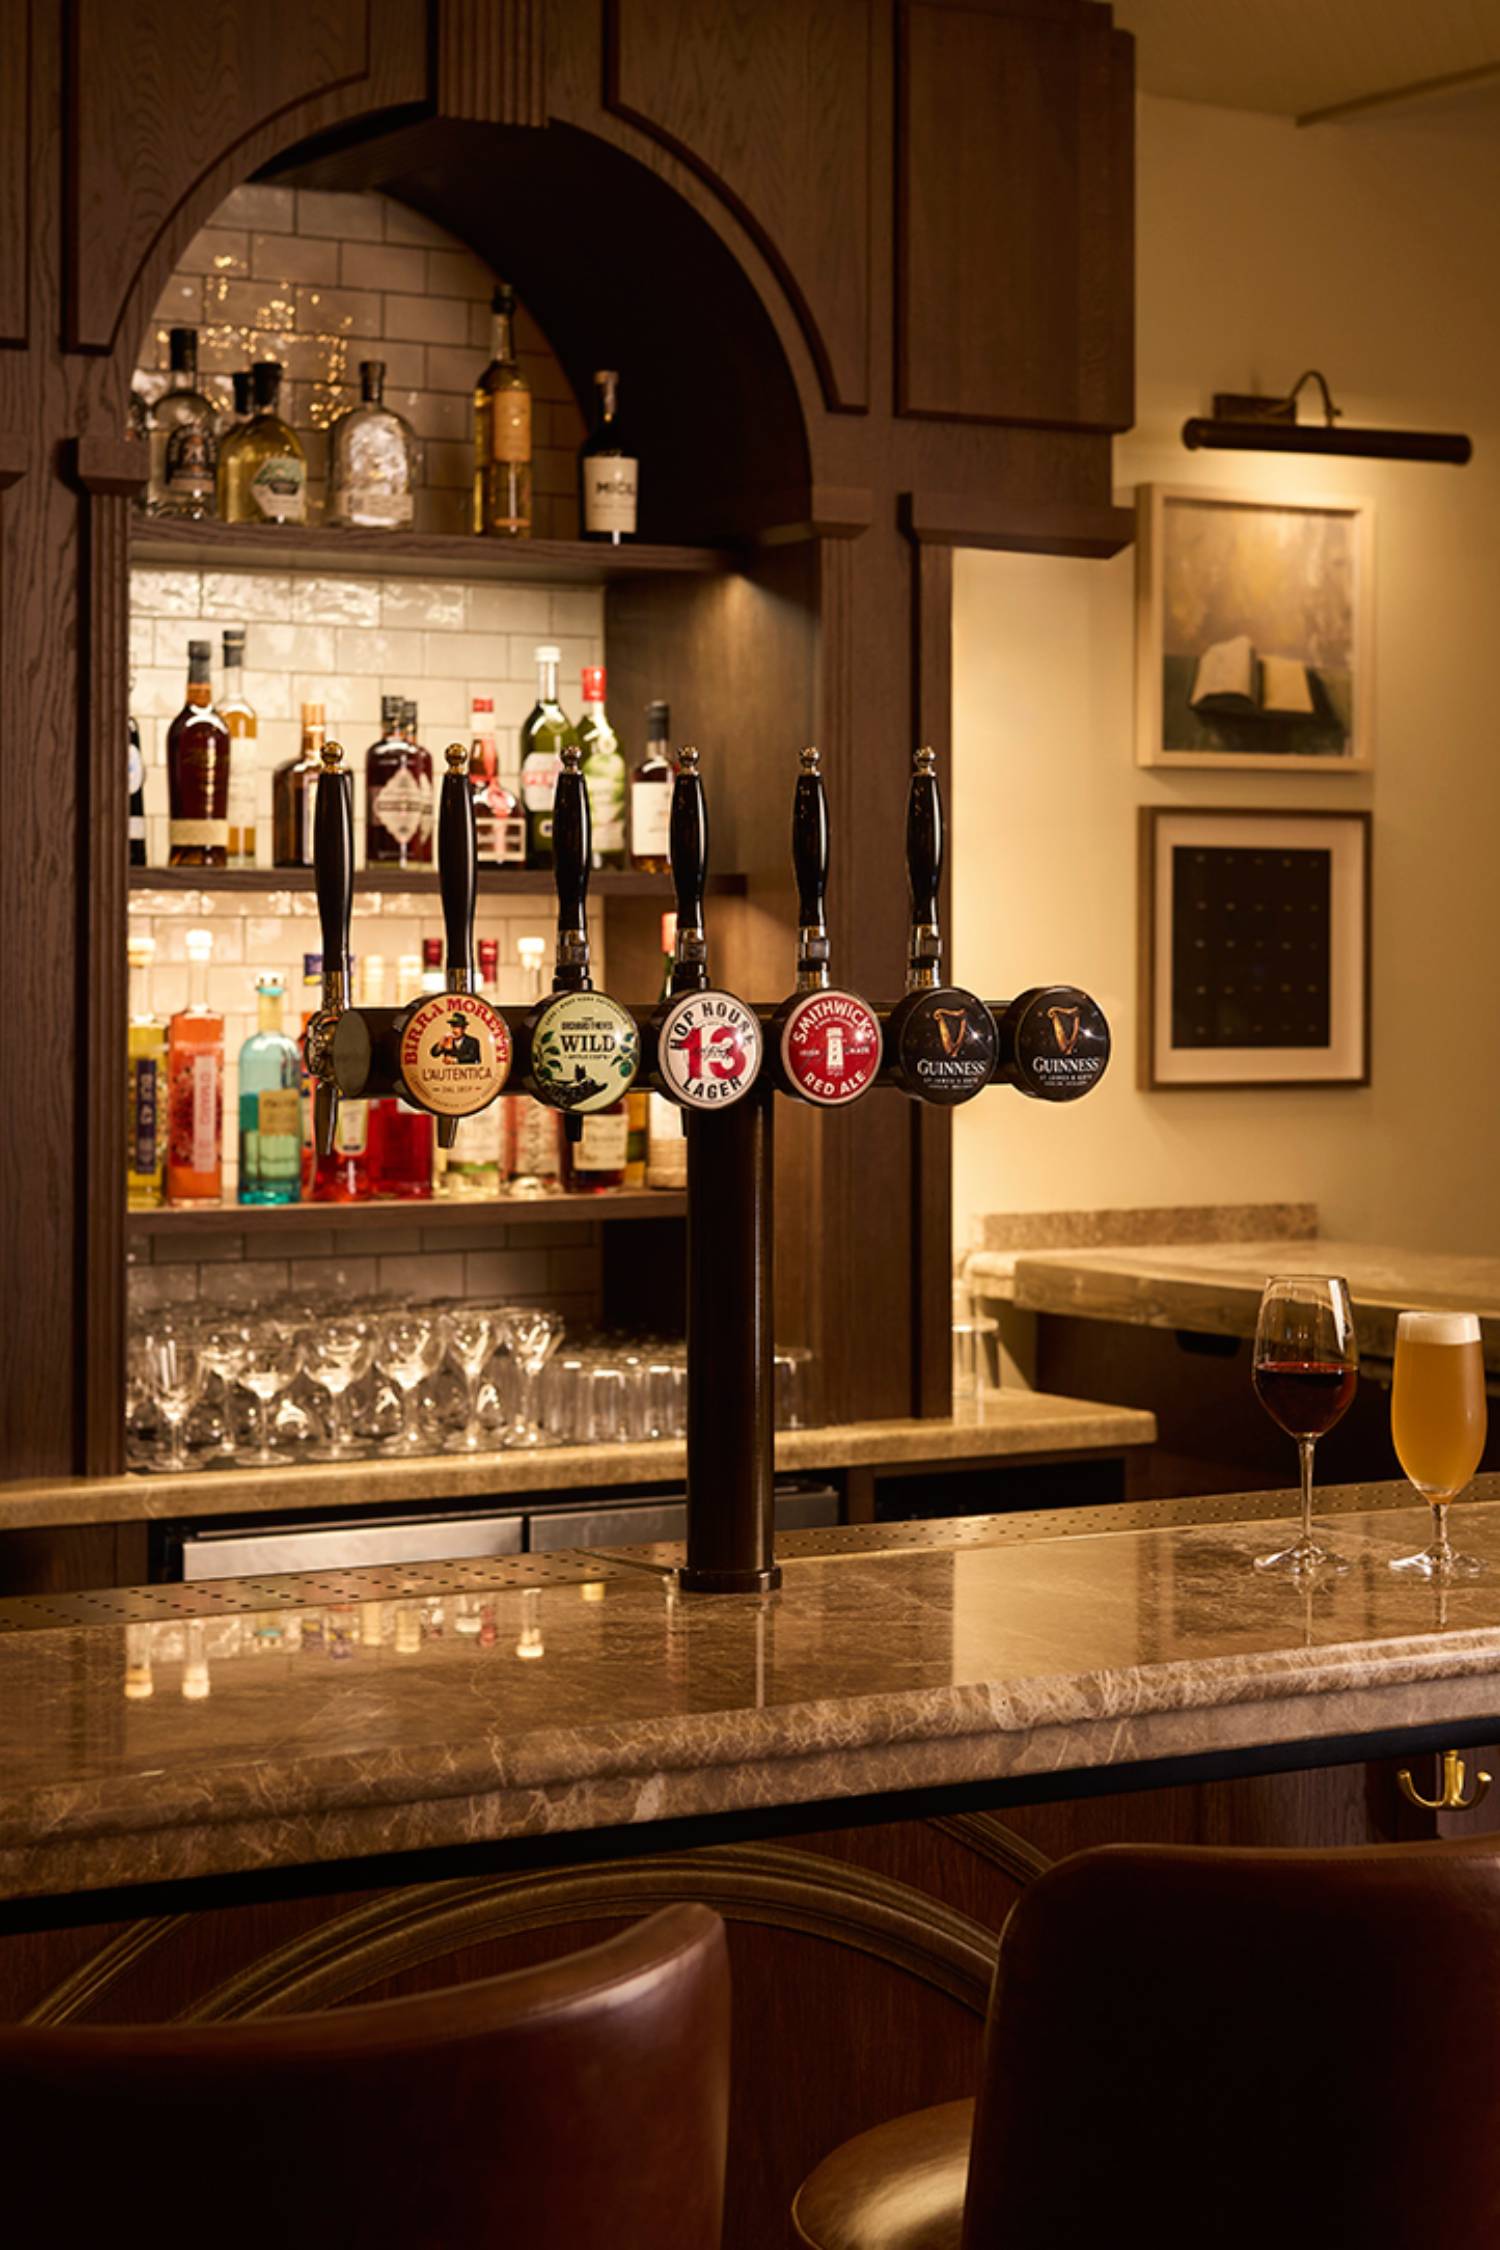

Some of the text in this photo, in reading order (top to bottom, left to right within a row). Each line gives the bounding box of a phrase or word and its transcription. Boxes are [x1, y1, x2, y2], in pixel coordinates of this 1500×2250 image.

[404, 1003, 444, 1065] BIRRA
[446, 997, 509, 1064] MORETTI
[670, 1010, 695, 1050] HOP
[560, 1035, 616, 1053] WILD
[677, 1025, 747, 1080] 13
[422, 1067, 492, 1081] L'AUTENTICA
[917, 1058, 987, 1076] GUINNESS
[1033, 1056, 1100, 1073] GUINNESS
[682, 1076, 742, 1099] LAGER
[803, 1071, 866, 1095] RED ALE
